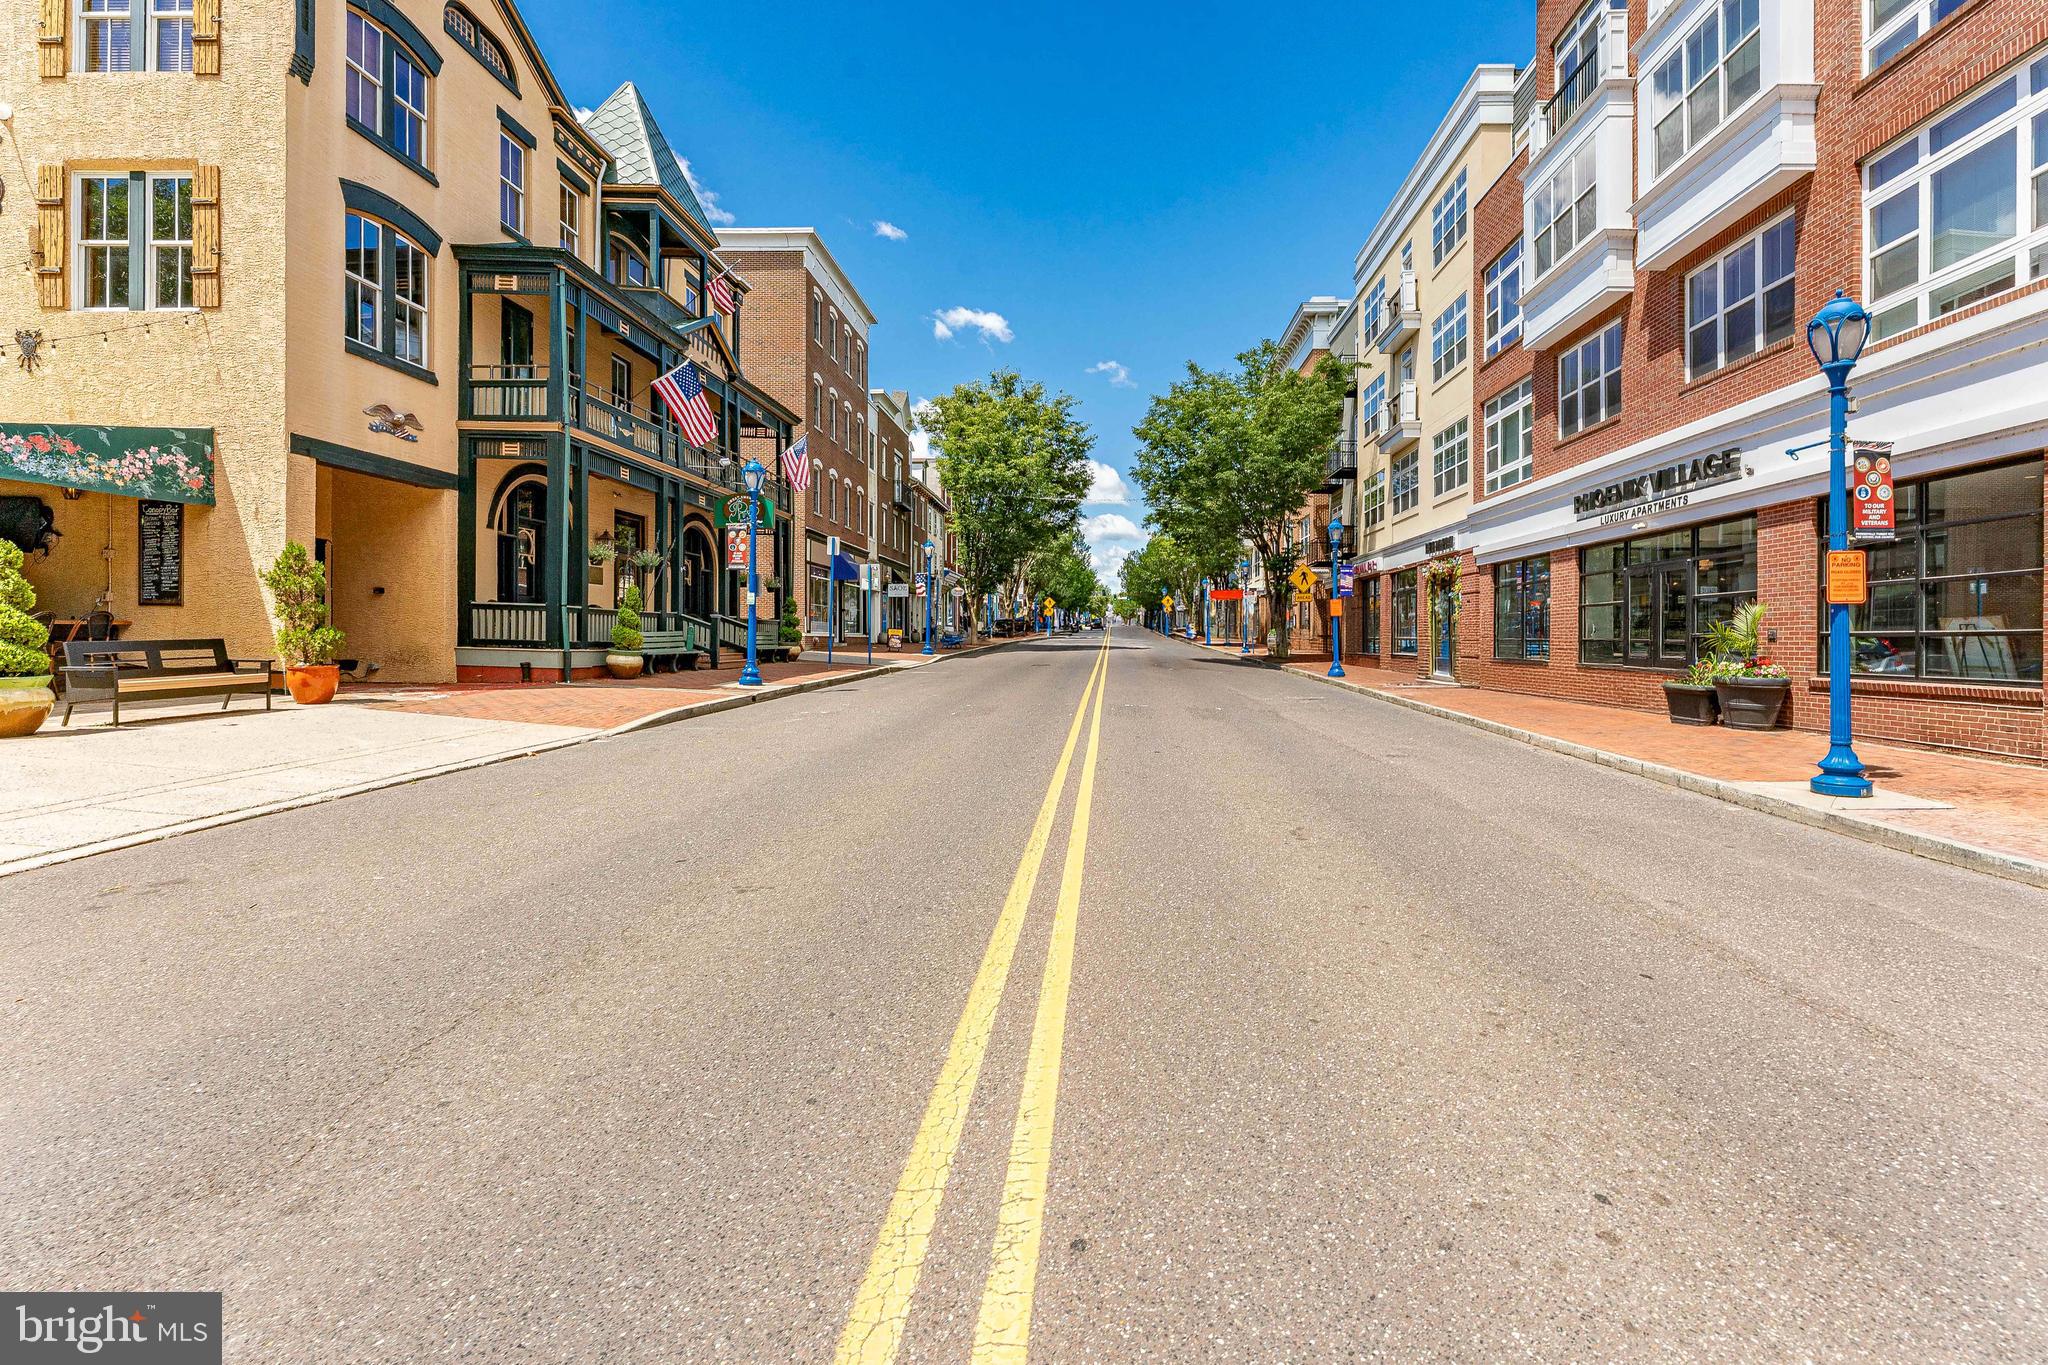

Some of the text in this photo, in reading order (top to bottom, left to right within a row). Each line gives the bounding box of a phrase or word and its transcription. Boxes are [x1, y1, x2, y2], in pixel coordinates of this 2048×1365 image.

[1574, 448, 1742, 514] PHOENIX VILLAGE
[1600, 494, 1689, 526] LUXURY APARTMENTS
